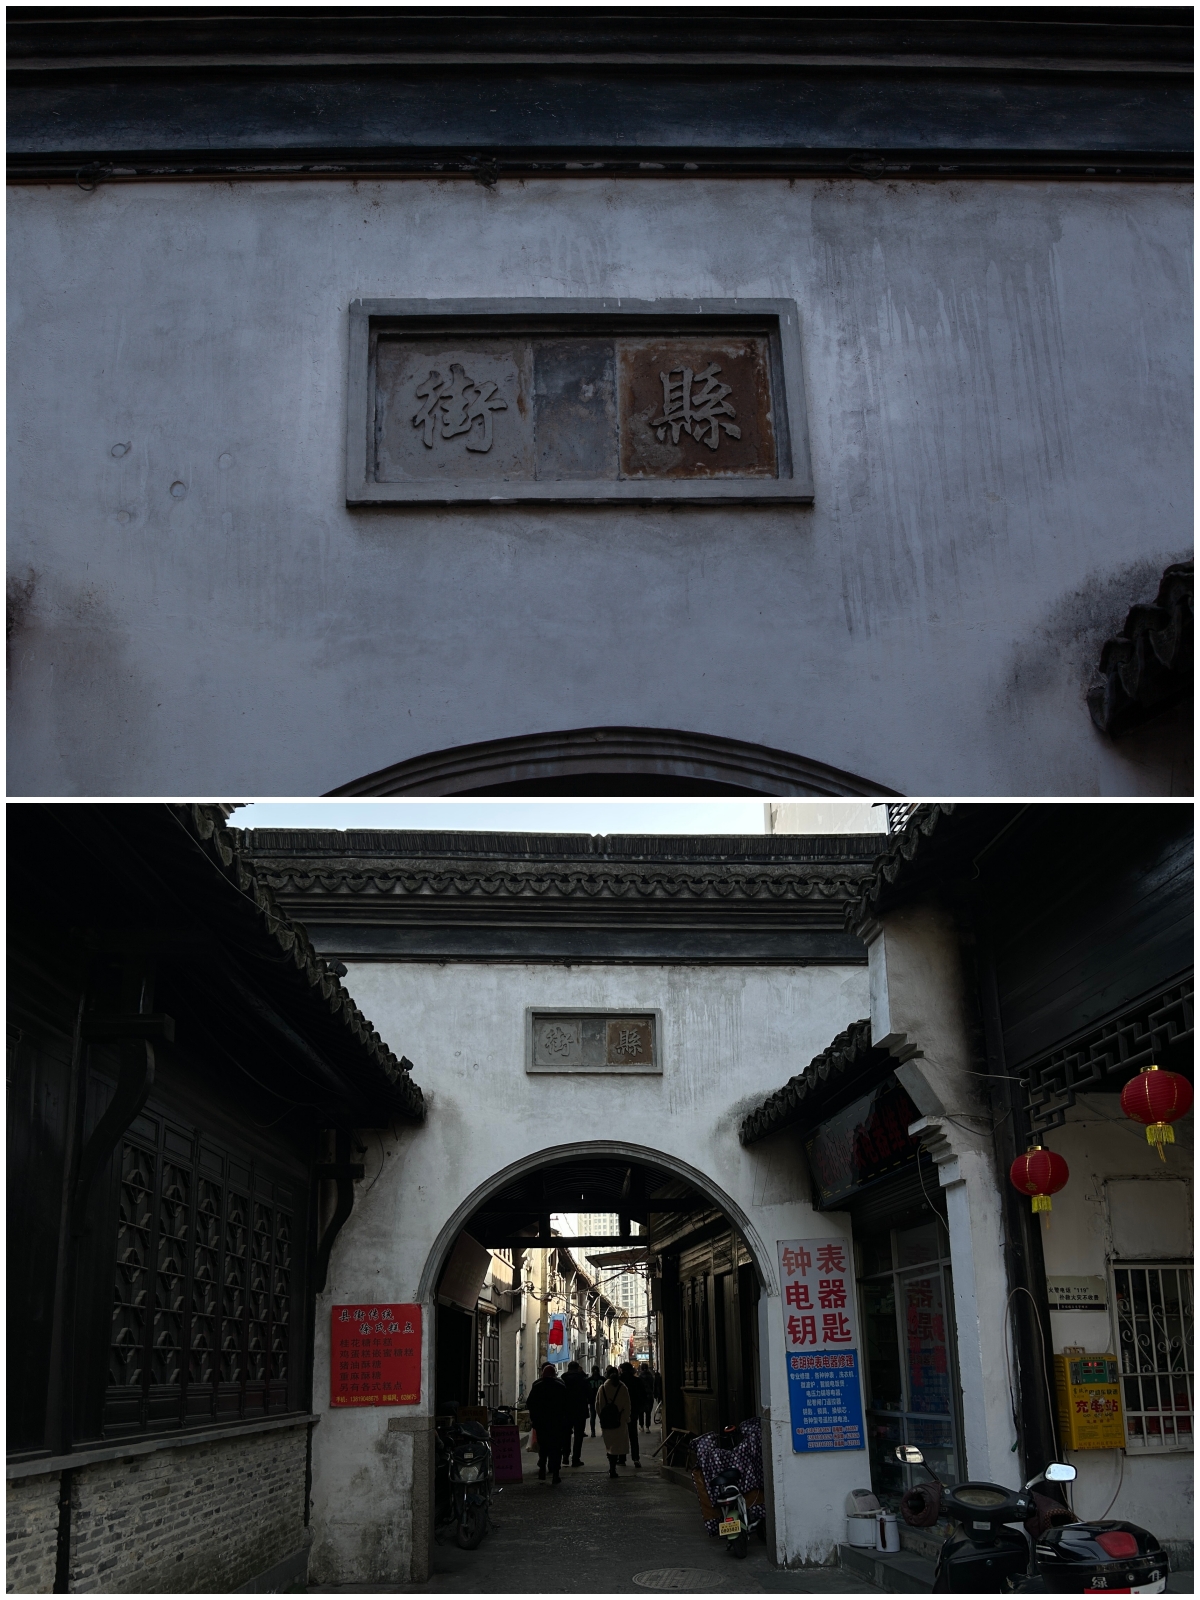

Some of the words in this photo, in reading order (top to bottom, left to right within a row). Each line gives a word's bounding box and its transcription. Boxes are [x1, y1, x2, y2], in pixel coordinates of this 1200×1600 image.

[782, 1243, 847, 1277] 钟表
[785, 1278, 848, 1311] 电器
[338, 1308, 395, 1322] 县街传统
[358, 1321, 415, 1335] 徐氏糕点
[787, 1311, 853, 1346] 钥匙
[339, 1337, 393, 1348] 桂花糖年糕
[339, 1359, 382, 1370] 猪油酥糖
[790, 1353, 855, 1370] 老胡钟表电器修理
[339, 1381, 403, 1392] 另有各式糕点
[1075, 1398, 1119, 1413] 充电站
